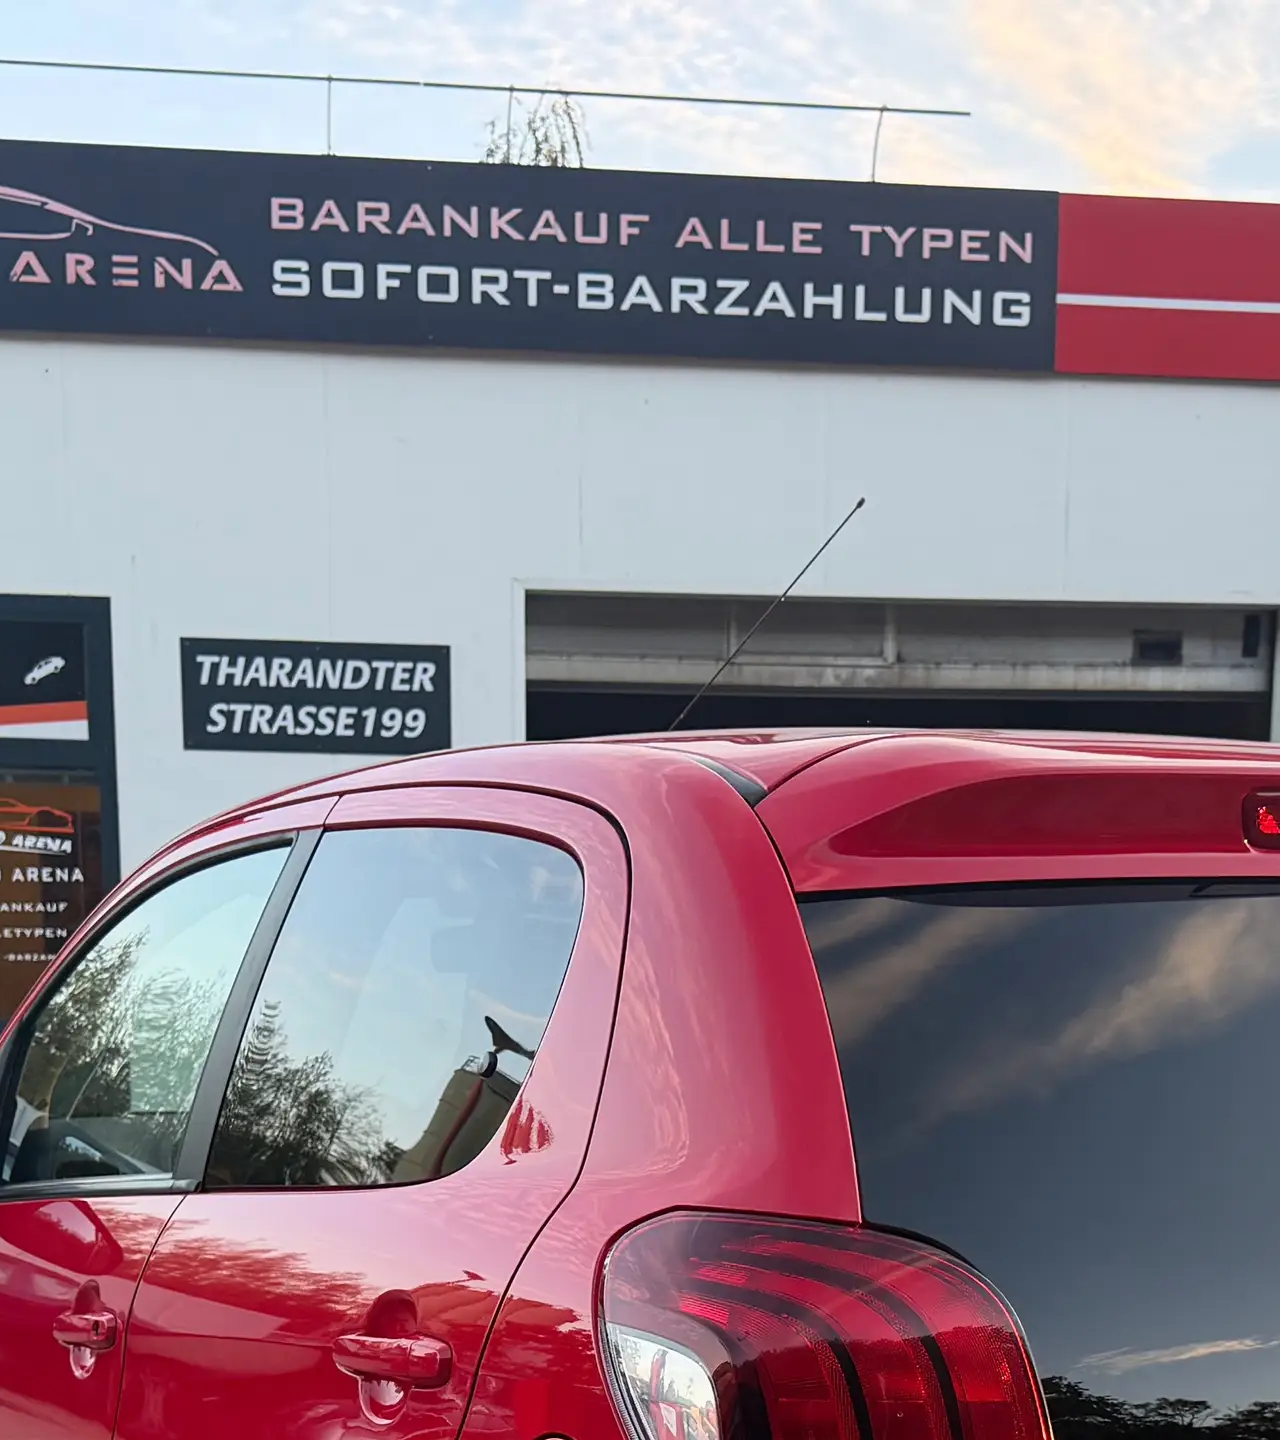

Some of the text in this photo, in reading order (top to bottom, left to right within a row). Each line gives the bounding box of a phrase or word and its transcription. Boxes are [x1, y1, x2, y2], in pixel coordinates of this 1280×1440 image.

[270, 196, 1034, 264] BARANKAUF ALLE TYPEN
[9, 250, 244, 293] ARENA
[271, 258, 1032, 328] SOFORT-BARZAHLUNG
[195, 654, 437, 693] THARANDTER
[12, 834, 73, 854] ARENA
[12, 867, 85, 884] ARENA
